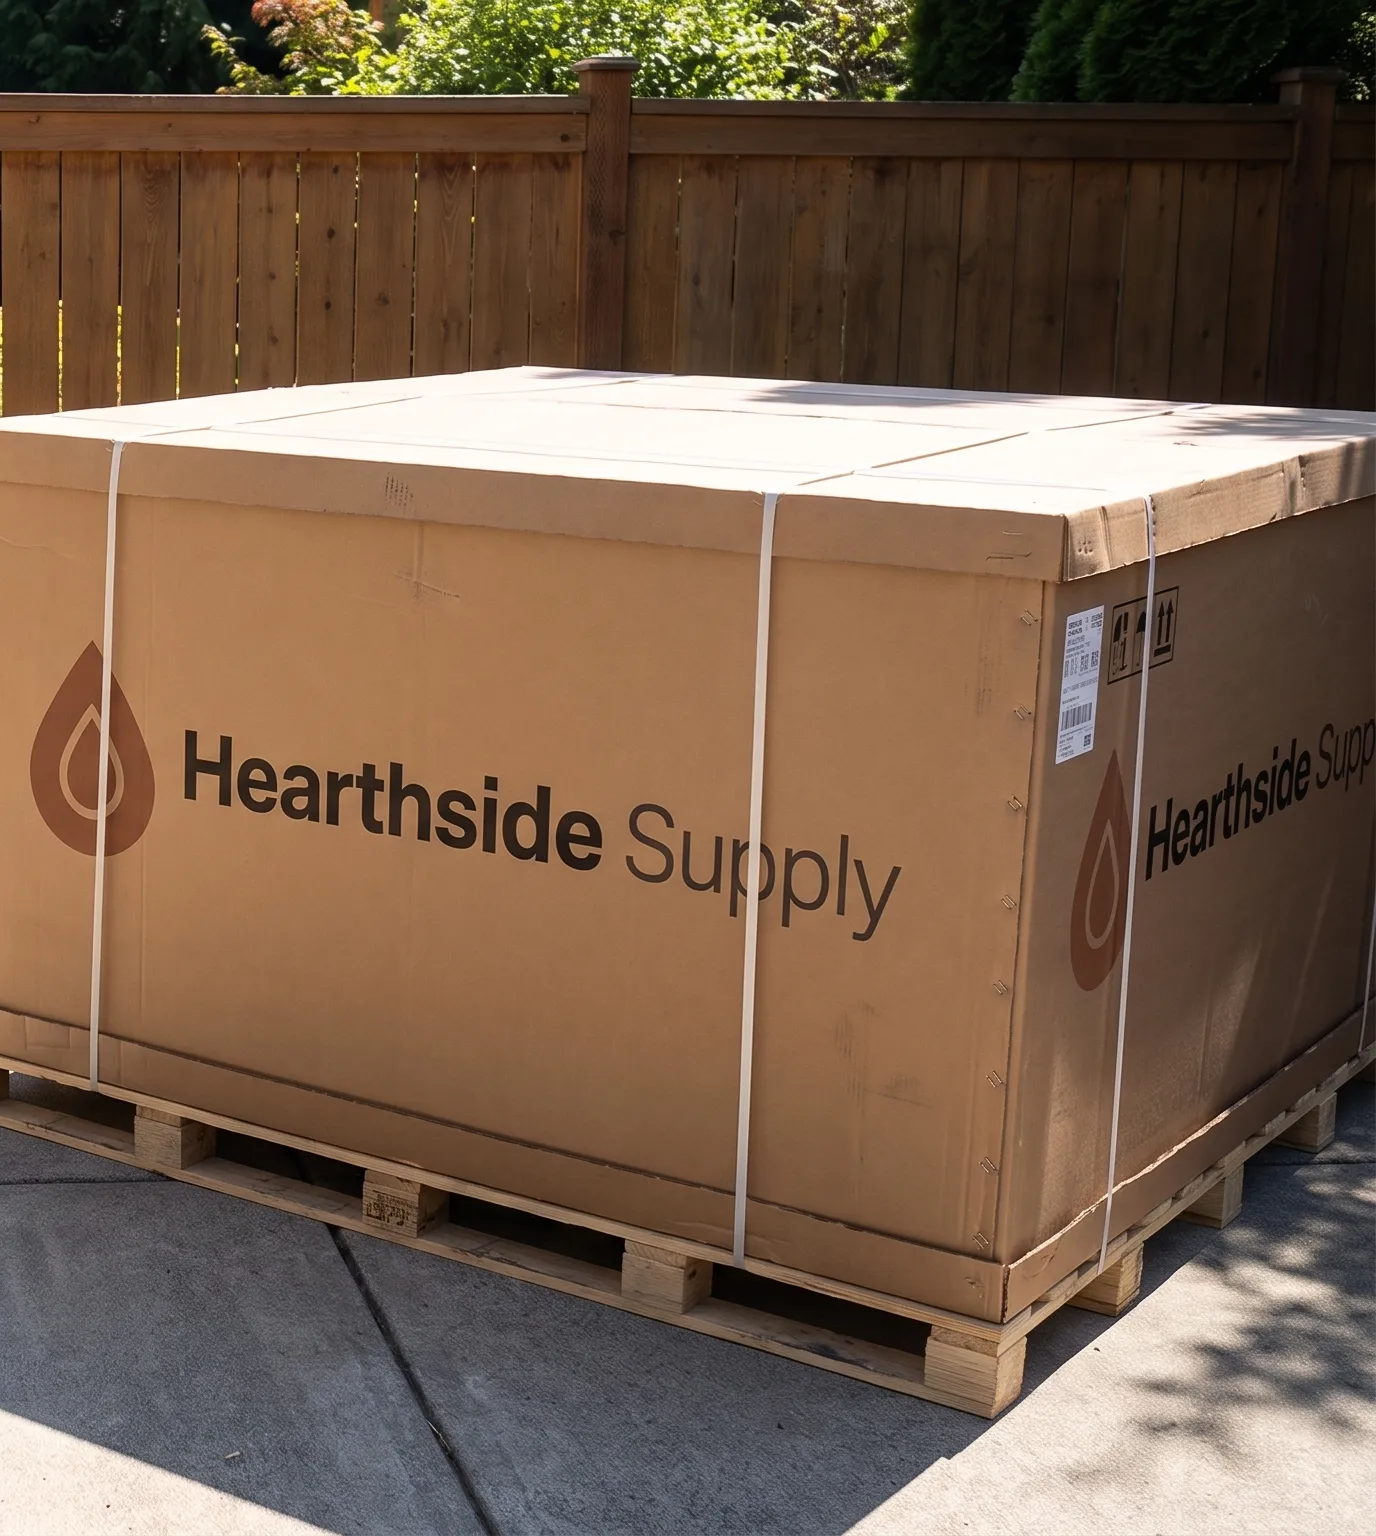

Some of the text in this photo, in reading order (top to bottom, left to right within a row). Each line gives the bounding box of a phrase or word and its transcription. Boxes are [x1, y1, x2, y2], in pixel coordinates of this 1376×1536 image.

[183, 729, 902, 943] Hearthside Supply
[1145, 737, 1311, 881] Hearthside
